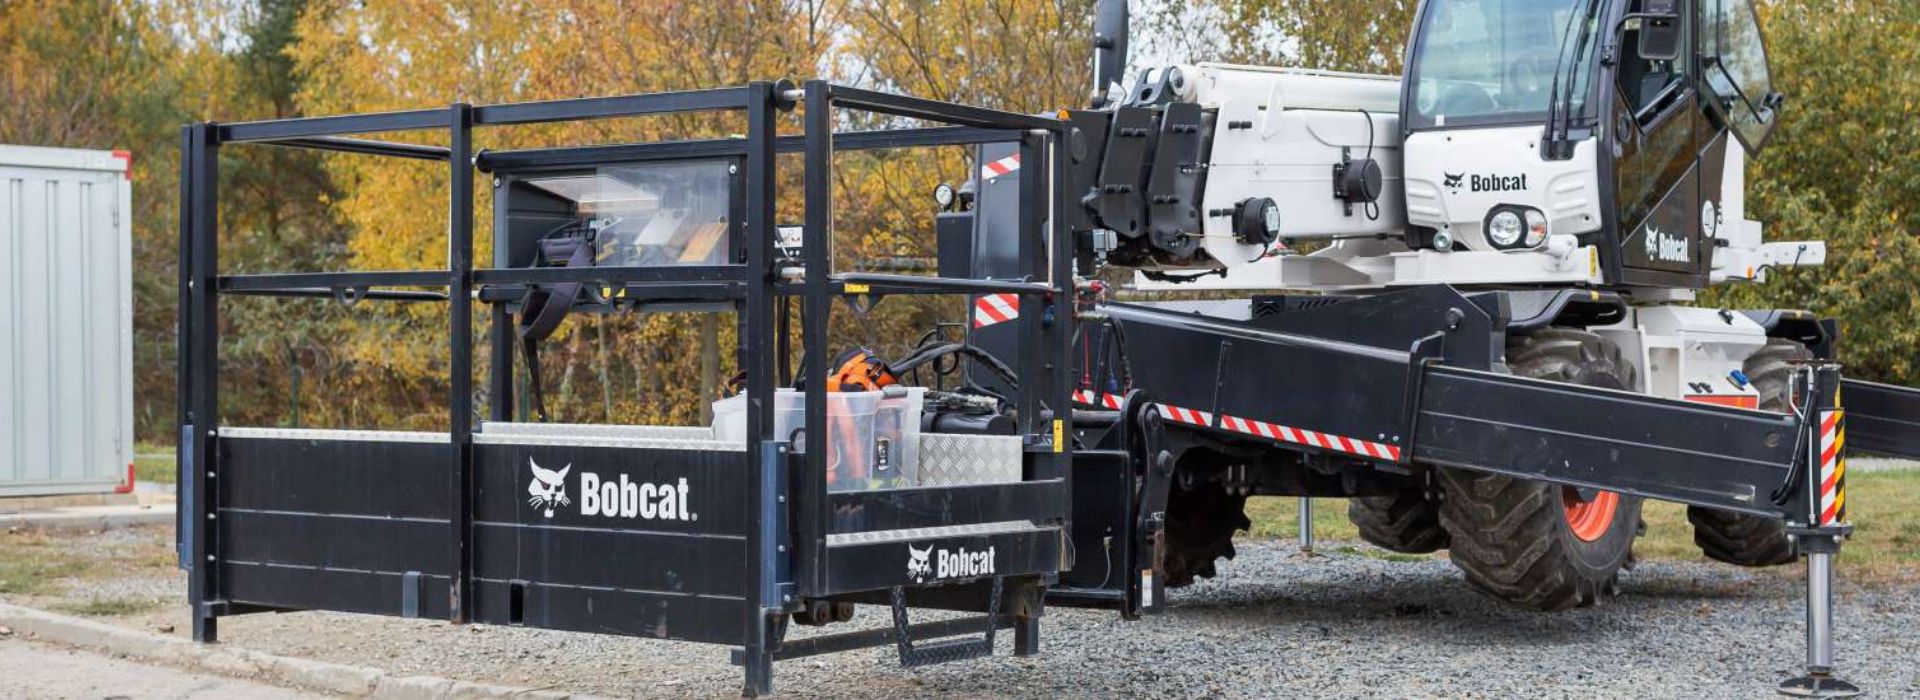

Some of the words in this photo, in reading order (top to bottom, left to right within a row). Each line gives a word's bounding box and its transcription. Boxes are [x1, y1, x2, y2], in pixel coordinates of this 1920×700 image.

[1471, 173, 1527, 192] Bobcat
[580, 472, 689, 521] Bobcat
[937, 546, 995, 578] Bobcat
